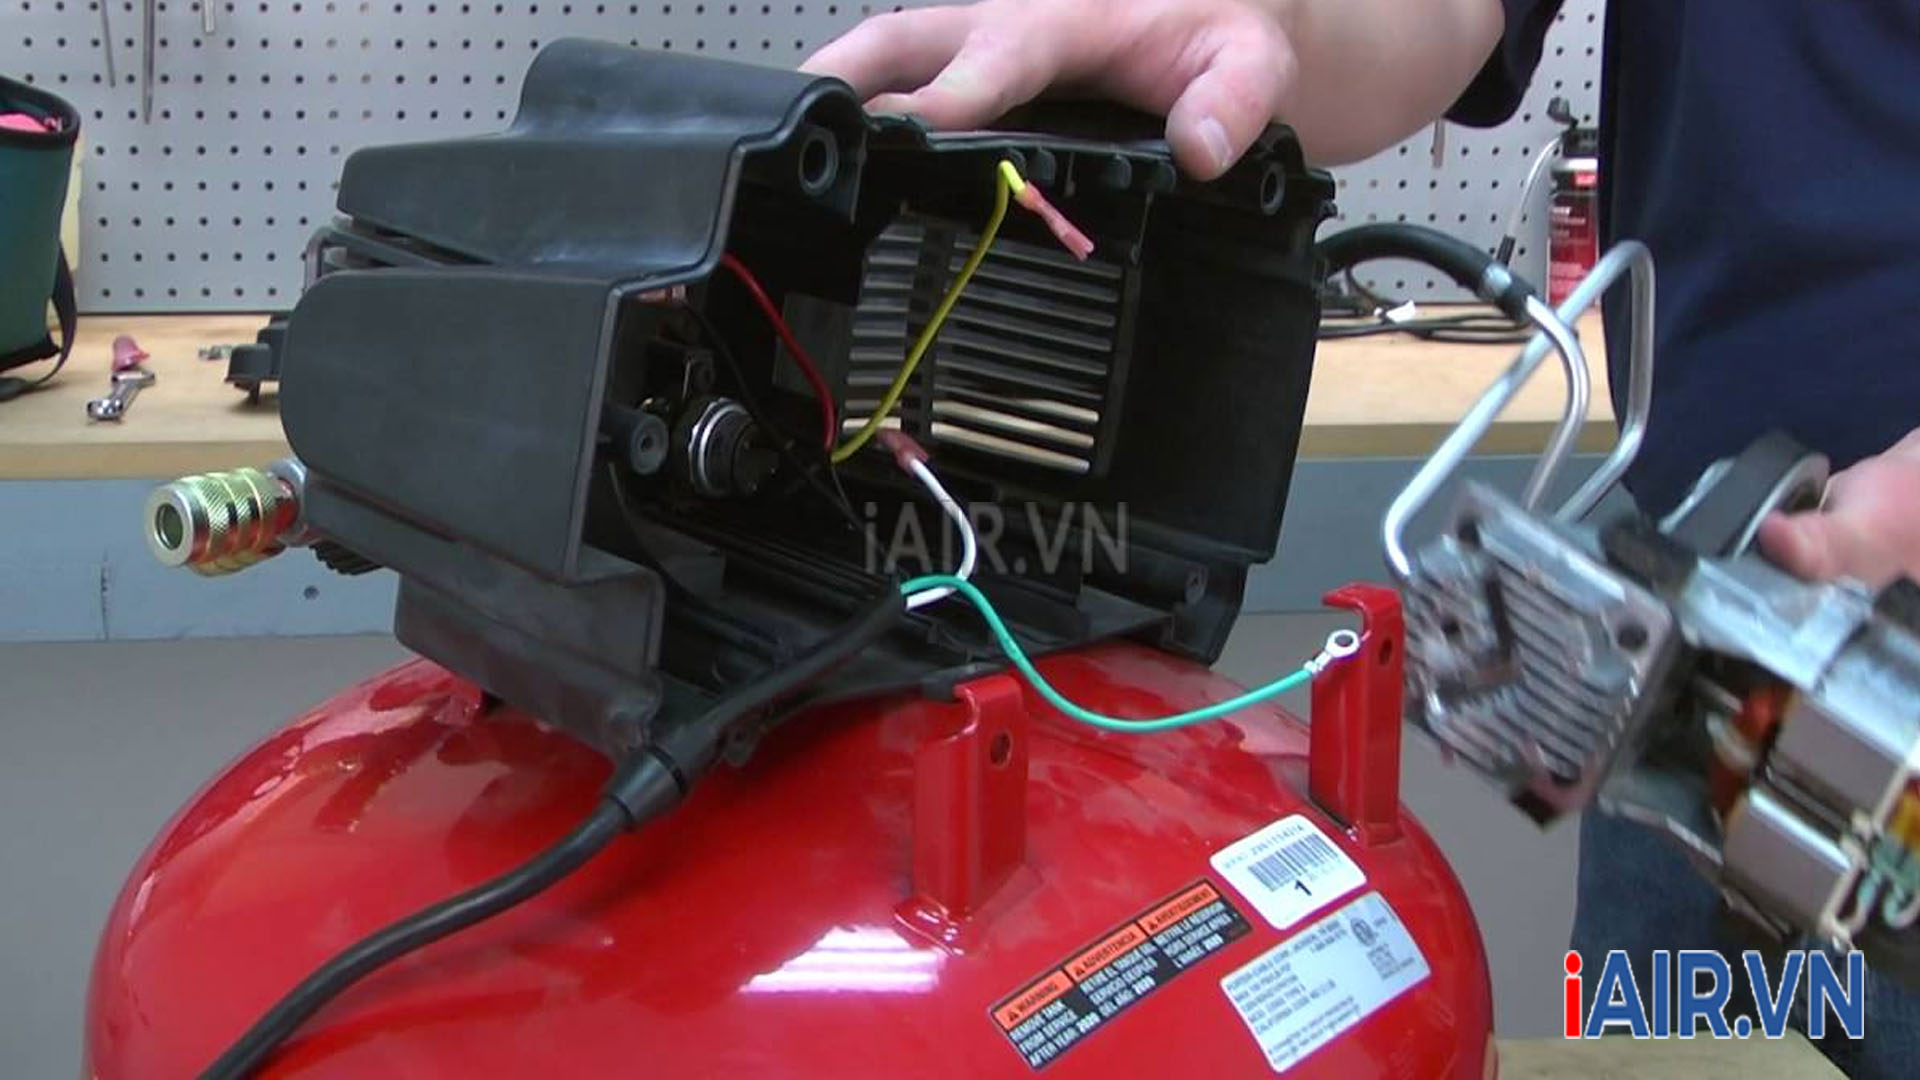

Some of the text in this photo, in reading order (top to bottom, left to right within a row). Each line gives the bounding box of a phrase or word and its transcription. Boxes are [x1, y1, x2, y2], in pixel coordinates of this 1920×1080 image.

[1294, 880, 1312, 896] 1
[1082, 931, 1137, 969] ADVERTENCIA
[1015, 980, 1059, 1012] WARNING
[1009, 998, 1066, 1042] REMOVE TANK
[1018, 1008, 1077, 1054] FROM SERVICE
[1027, 1040, 1058, 1067] AFTER
